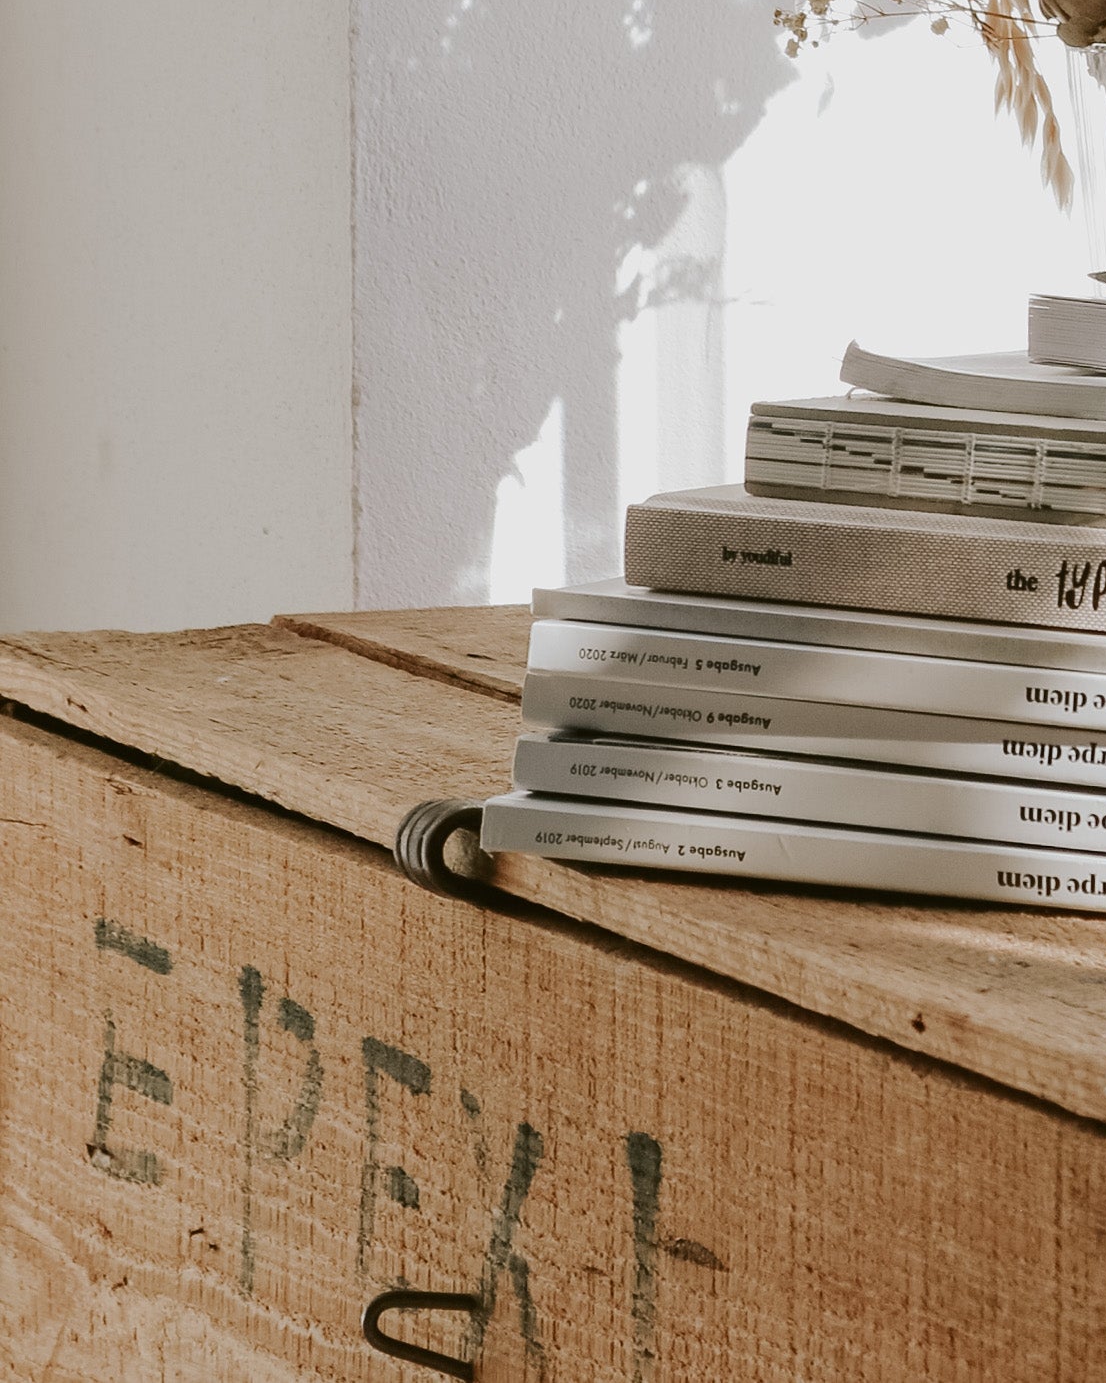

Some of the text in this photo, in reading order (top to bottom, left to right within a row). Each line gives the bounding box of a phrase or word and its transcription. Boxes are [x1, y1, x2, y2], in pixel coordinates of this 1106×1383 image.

[1006, 569, 1039, 592] the
[578, 648, 607, 662] 2020
[695, 660, 704, 671] 5
[706, 659, 762, 677] Ausgabe
[569, 696, 597, 711] 2020
[1025, 687, 1088, 713] diem
[706, 712, 715, 724] 9
[718, 711, 772, 730] Ausgabe
[1002, 740, 1062, 766] diem
[570, 763, 597, 777] 2019
[715, 778, 723, 790] 3
[727, 778, 782, 796] Ausgabe
[1019, 806, 1081, 832] diem
[535, 831, 563, 845] 2019
[677, 844, 686, 856] 2
[689, 844, 746, 862] Ausgabe
[997, 871, 1061, 897] diem
